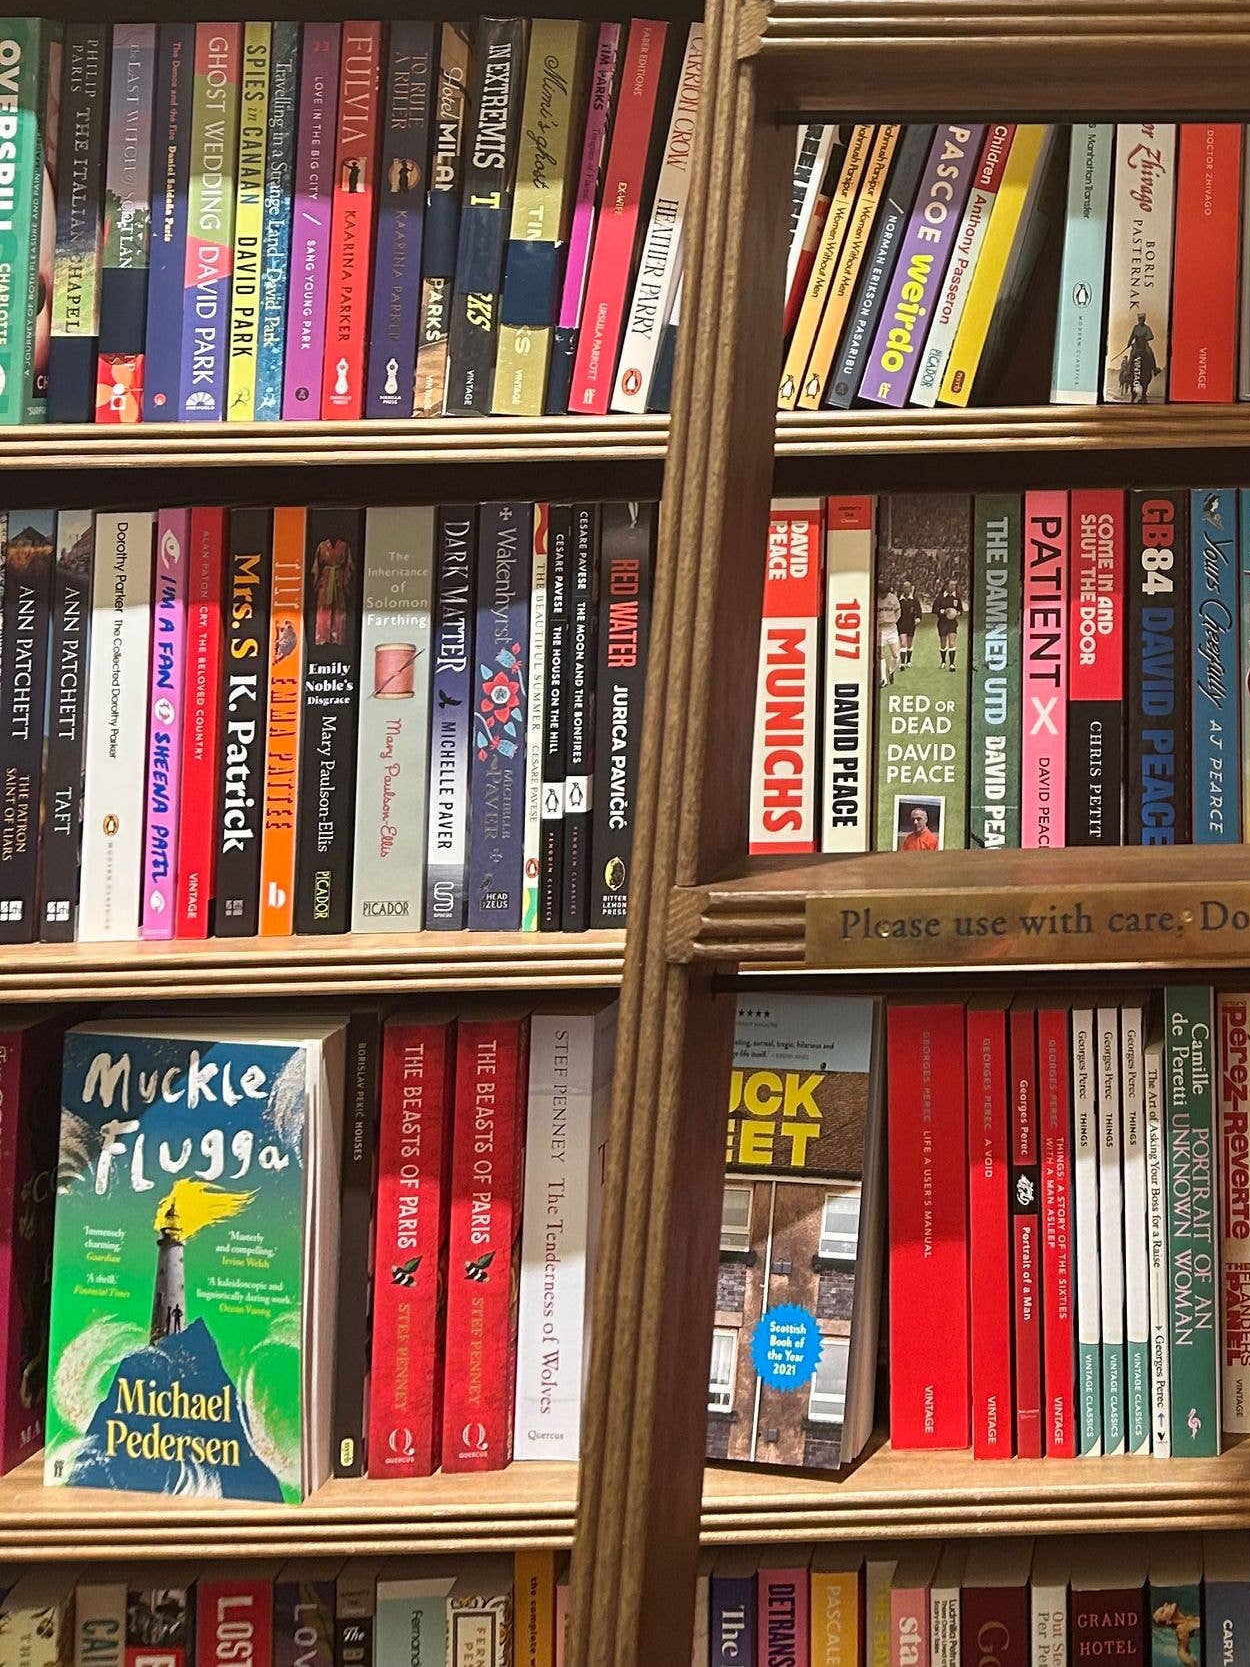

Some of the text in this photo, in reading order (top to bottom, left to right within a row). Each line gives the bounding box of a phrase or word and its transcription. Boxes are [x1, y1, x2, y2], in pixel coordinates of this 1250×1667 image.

[343, 37, 371, 144] FULVIA
[881, 127, 970, 373] PASCOE weirdo
[338, 210, 355, 342] KAARINA PARKER
[192, 245, 219, 385] DAVID PARK
[834, 598, 860, 660] 1977
[58, 588, 81, 740] ANN PATCHETT
[305, 679, 354, 692] Noble's
[308, 662, 350, 677] Emily
[222, 555, 261, 853] Mrs. S K. Patrick
[307, 696, 350, 706] Disgrace
[889, 695, 954, 713] RED OR
[764, 629, 805, 832] MUNICHS
[891, 717, 951, 734] DEAD
[887, 744, 955, 762] DAVID
[887, 766, 955, 783] PEACE
[317, 716, 337, 853] Mary Paulson-Ellis
[841, 909, 940, 941] Please
[956, 914, 1007, 936] use
[1020, 904, 1092, 935] with
[1108, 909, 1184, 933] care.
[83, 1050, 268, 1112] Muckle
[94, 1117, 290, 1195] Flugga
[398, 1044, 424, 1249] THE BEASTS OF PARIS
[770, 1321, 806, 1334] Scottish
[770, 1335, 805, 1348] Book of
[768, 1349, 804, 1362] the Year
[773, 1363, 796, 1375] 2021
[114, 1376, 232, 1423] Michael
[924, 1385, 934, 1434] VINTAGE
[104, 1419, 240, 1468] Pedersen
[1078, 1612, 1138, 1627] GRAND
[1080, 1642, 1136, 1656] HOTEL
